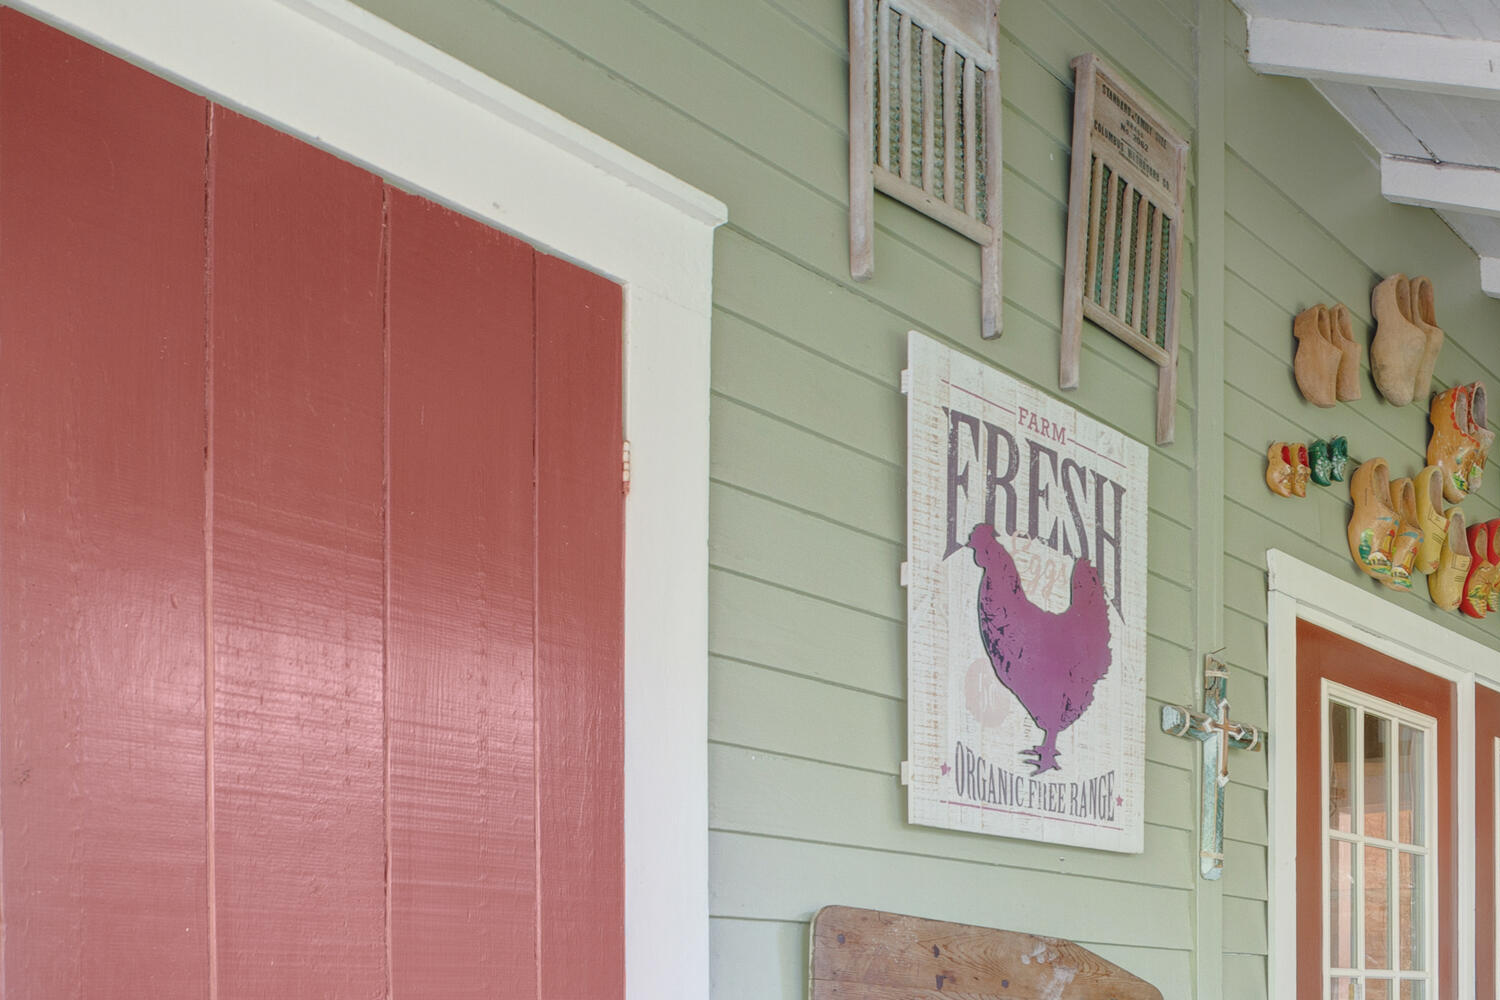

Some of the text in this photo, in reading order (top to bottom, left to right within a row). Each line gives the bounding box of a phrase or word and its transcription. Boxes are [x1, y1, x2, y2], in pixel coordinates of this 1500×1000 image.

[1018, 406, 1067, 446] FARM
[941, 405, 1127, 626] FRESH
[954, 740, 1116, 823] ORGANIC FREE RANGE
